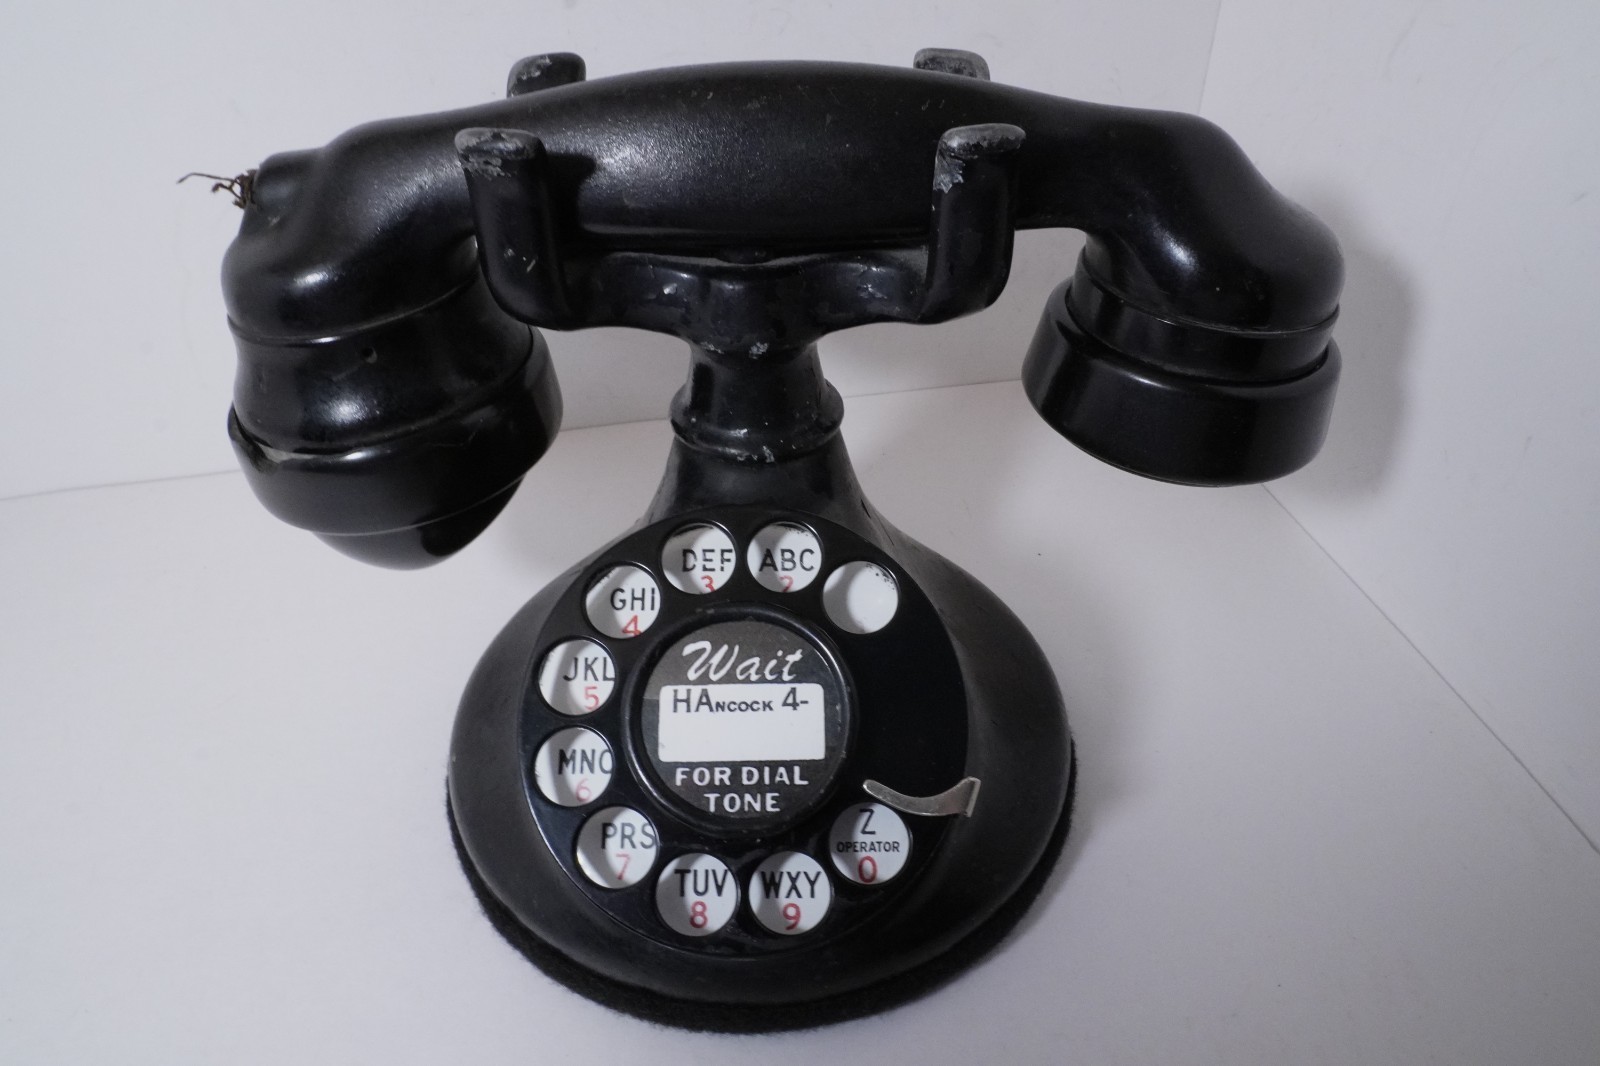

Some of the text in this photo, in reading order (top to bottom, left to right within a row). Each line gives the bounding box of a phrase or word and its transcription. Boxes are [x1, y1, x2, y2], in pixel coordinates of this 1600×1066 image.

[681, 548, 734, 572] DEF
[758, 548, 816, 572] ABC
[700, 574, 716, 592] 3
[779, 575, 794, 592] 2
[610, 587, 656, 611] GHI
[621, 614, 642, 637] 4
[562, 656, 616, 682] JKL
[681, 640, 803, 682] Wait
[583, 685, 600, 711] 5
[674, 765, 809, 787] FOR DIAL
[575, 778, 592, 803] 6
[703, 792, 781, 813] TONE
[859, 808, 876, 835] Z
[600, 822, 657, 851] PRS
[836, 840, 901, 853] OPERATOR
[615, 853, 631, 881] 7
[674, 868, 729, 898] TUV
[760, 871, 822, 899] WXY
[689, 900, 709, 929] 8
[782, 902, 801, 931] 9
